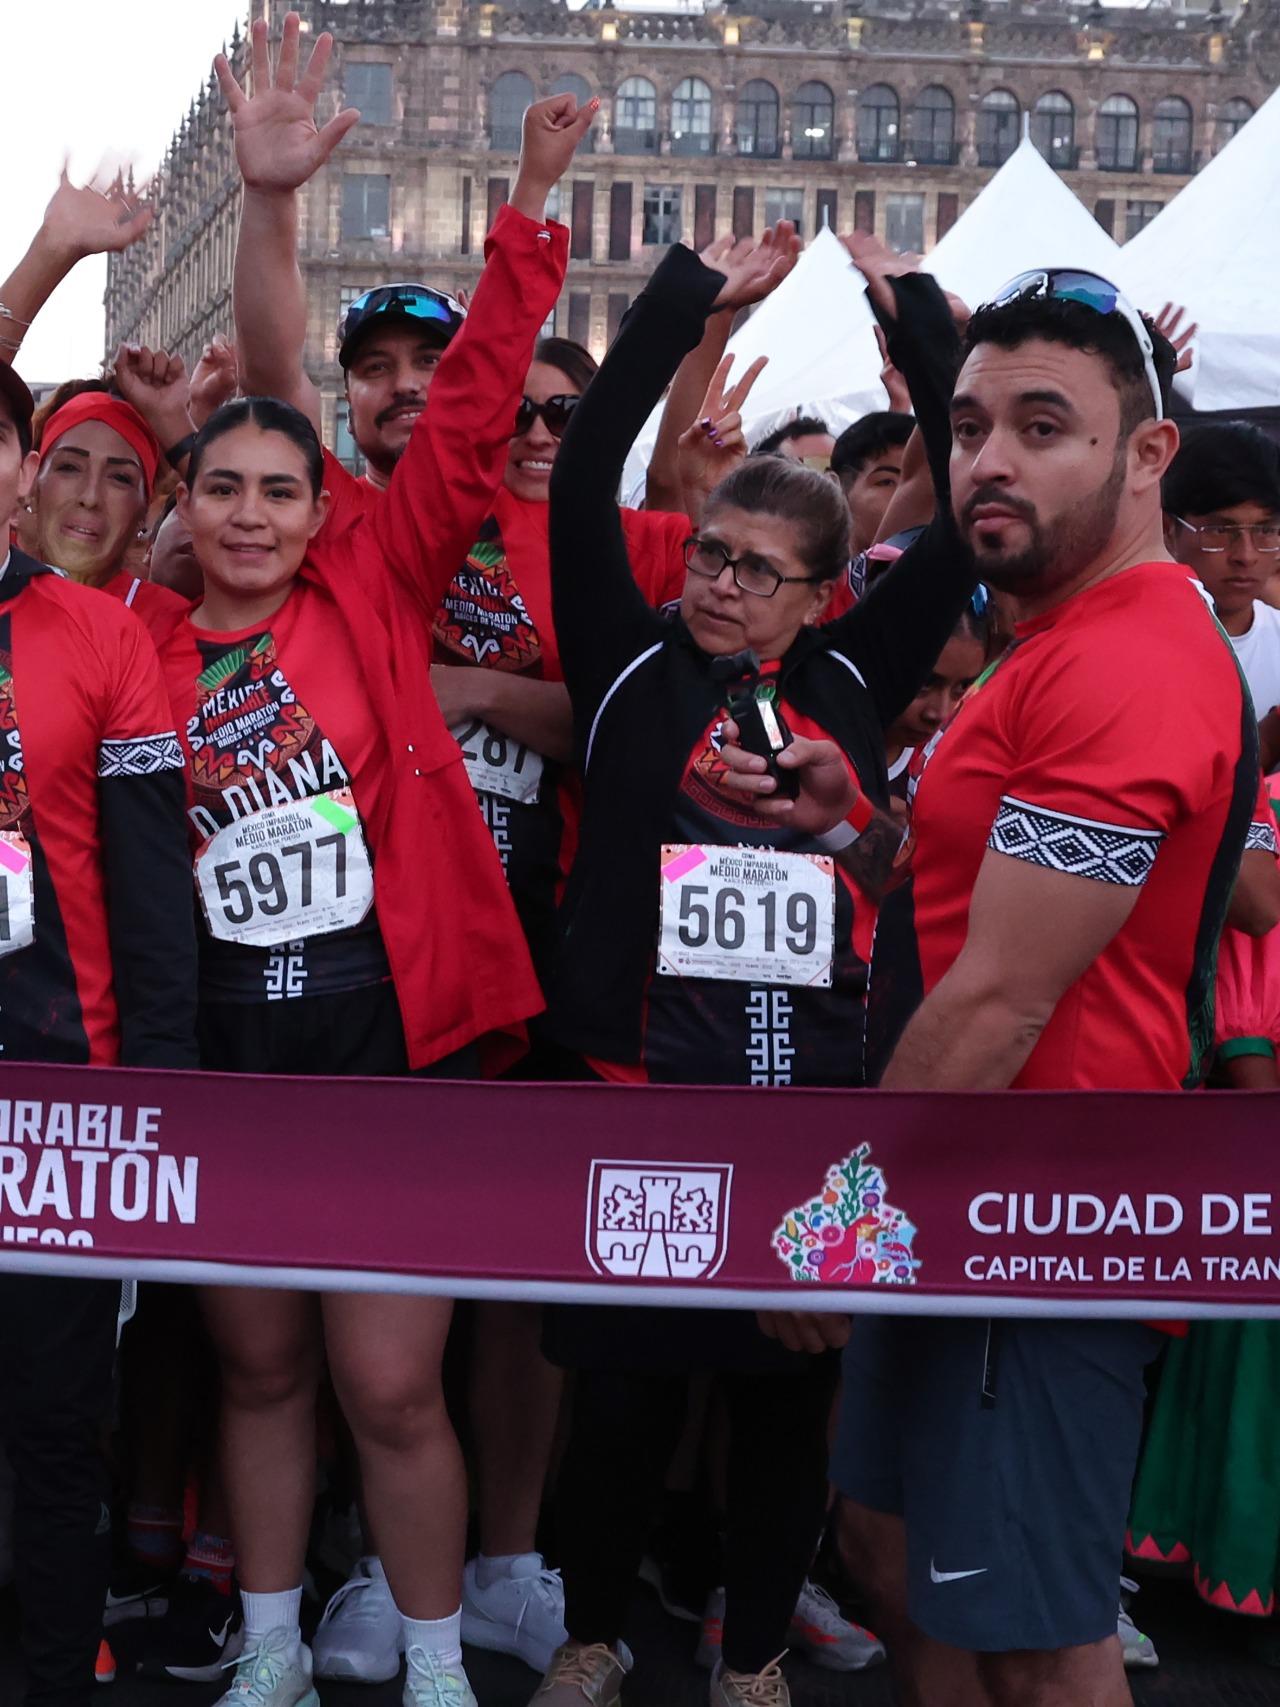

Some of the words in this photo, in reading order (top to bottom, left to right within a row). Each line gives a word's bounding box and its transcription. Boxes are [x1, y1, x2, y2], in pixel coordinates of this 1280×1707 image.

[446, 599, 475, 614] MEDIO
[206, 722, 235, 745] MEDIO
[235, 701, 280, 731] MARATÓN
[222, 739, 348, 822] DIANA
[236, 830, 266, 848] MEDIO
[267, 817, 313, 839] MARATÓN
[214, 833, 347, 924] 5977
[710, 865, 740, 878] MEDIO
[743, 868, 788, 882] MARATÓN
[720, 856, 743, 867] MÉXICO
[744, 860, 779, 870] IMPARABLE
[678, 885, 817, 955] 5619
[968, 1192, 1184, 1235] CIUDAD
[1201, 1193, 1272, 1235] DE
[964, 1255, 1093, 1281] CAPITAL
[1103, 1257, 1145, 1282] DE
[1154, 1257, 1192, 1282] LA
[1201, 1257, 1280, 1282] TRAN
